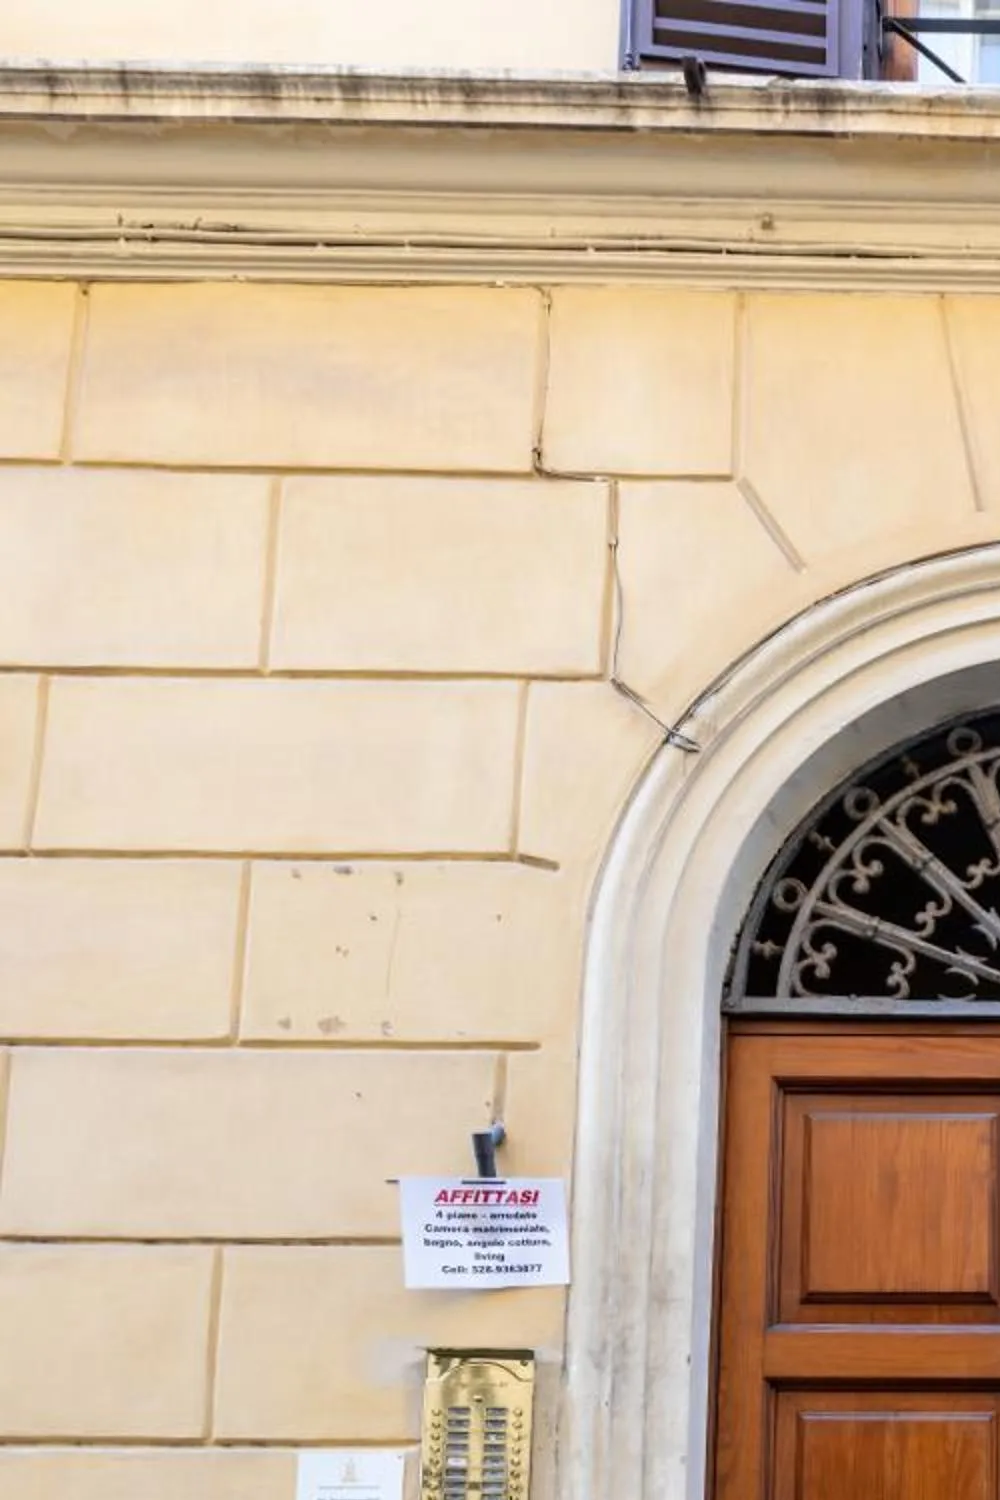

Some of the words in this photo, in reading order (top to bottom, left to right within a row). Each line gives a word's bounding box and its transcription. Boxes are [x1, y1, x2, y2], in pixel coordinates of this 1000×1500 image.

[434, 1189, 540, 1204] AFFITTASI
[424, 1223, 469, 1233] Camera
[473, 1252, 506, 1262] living
